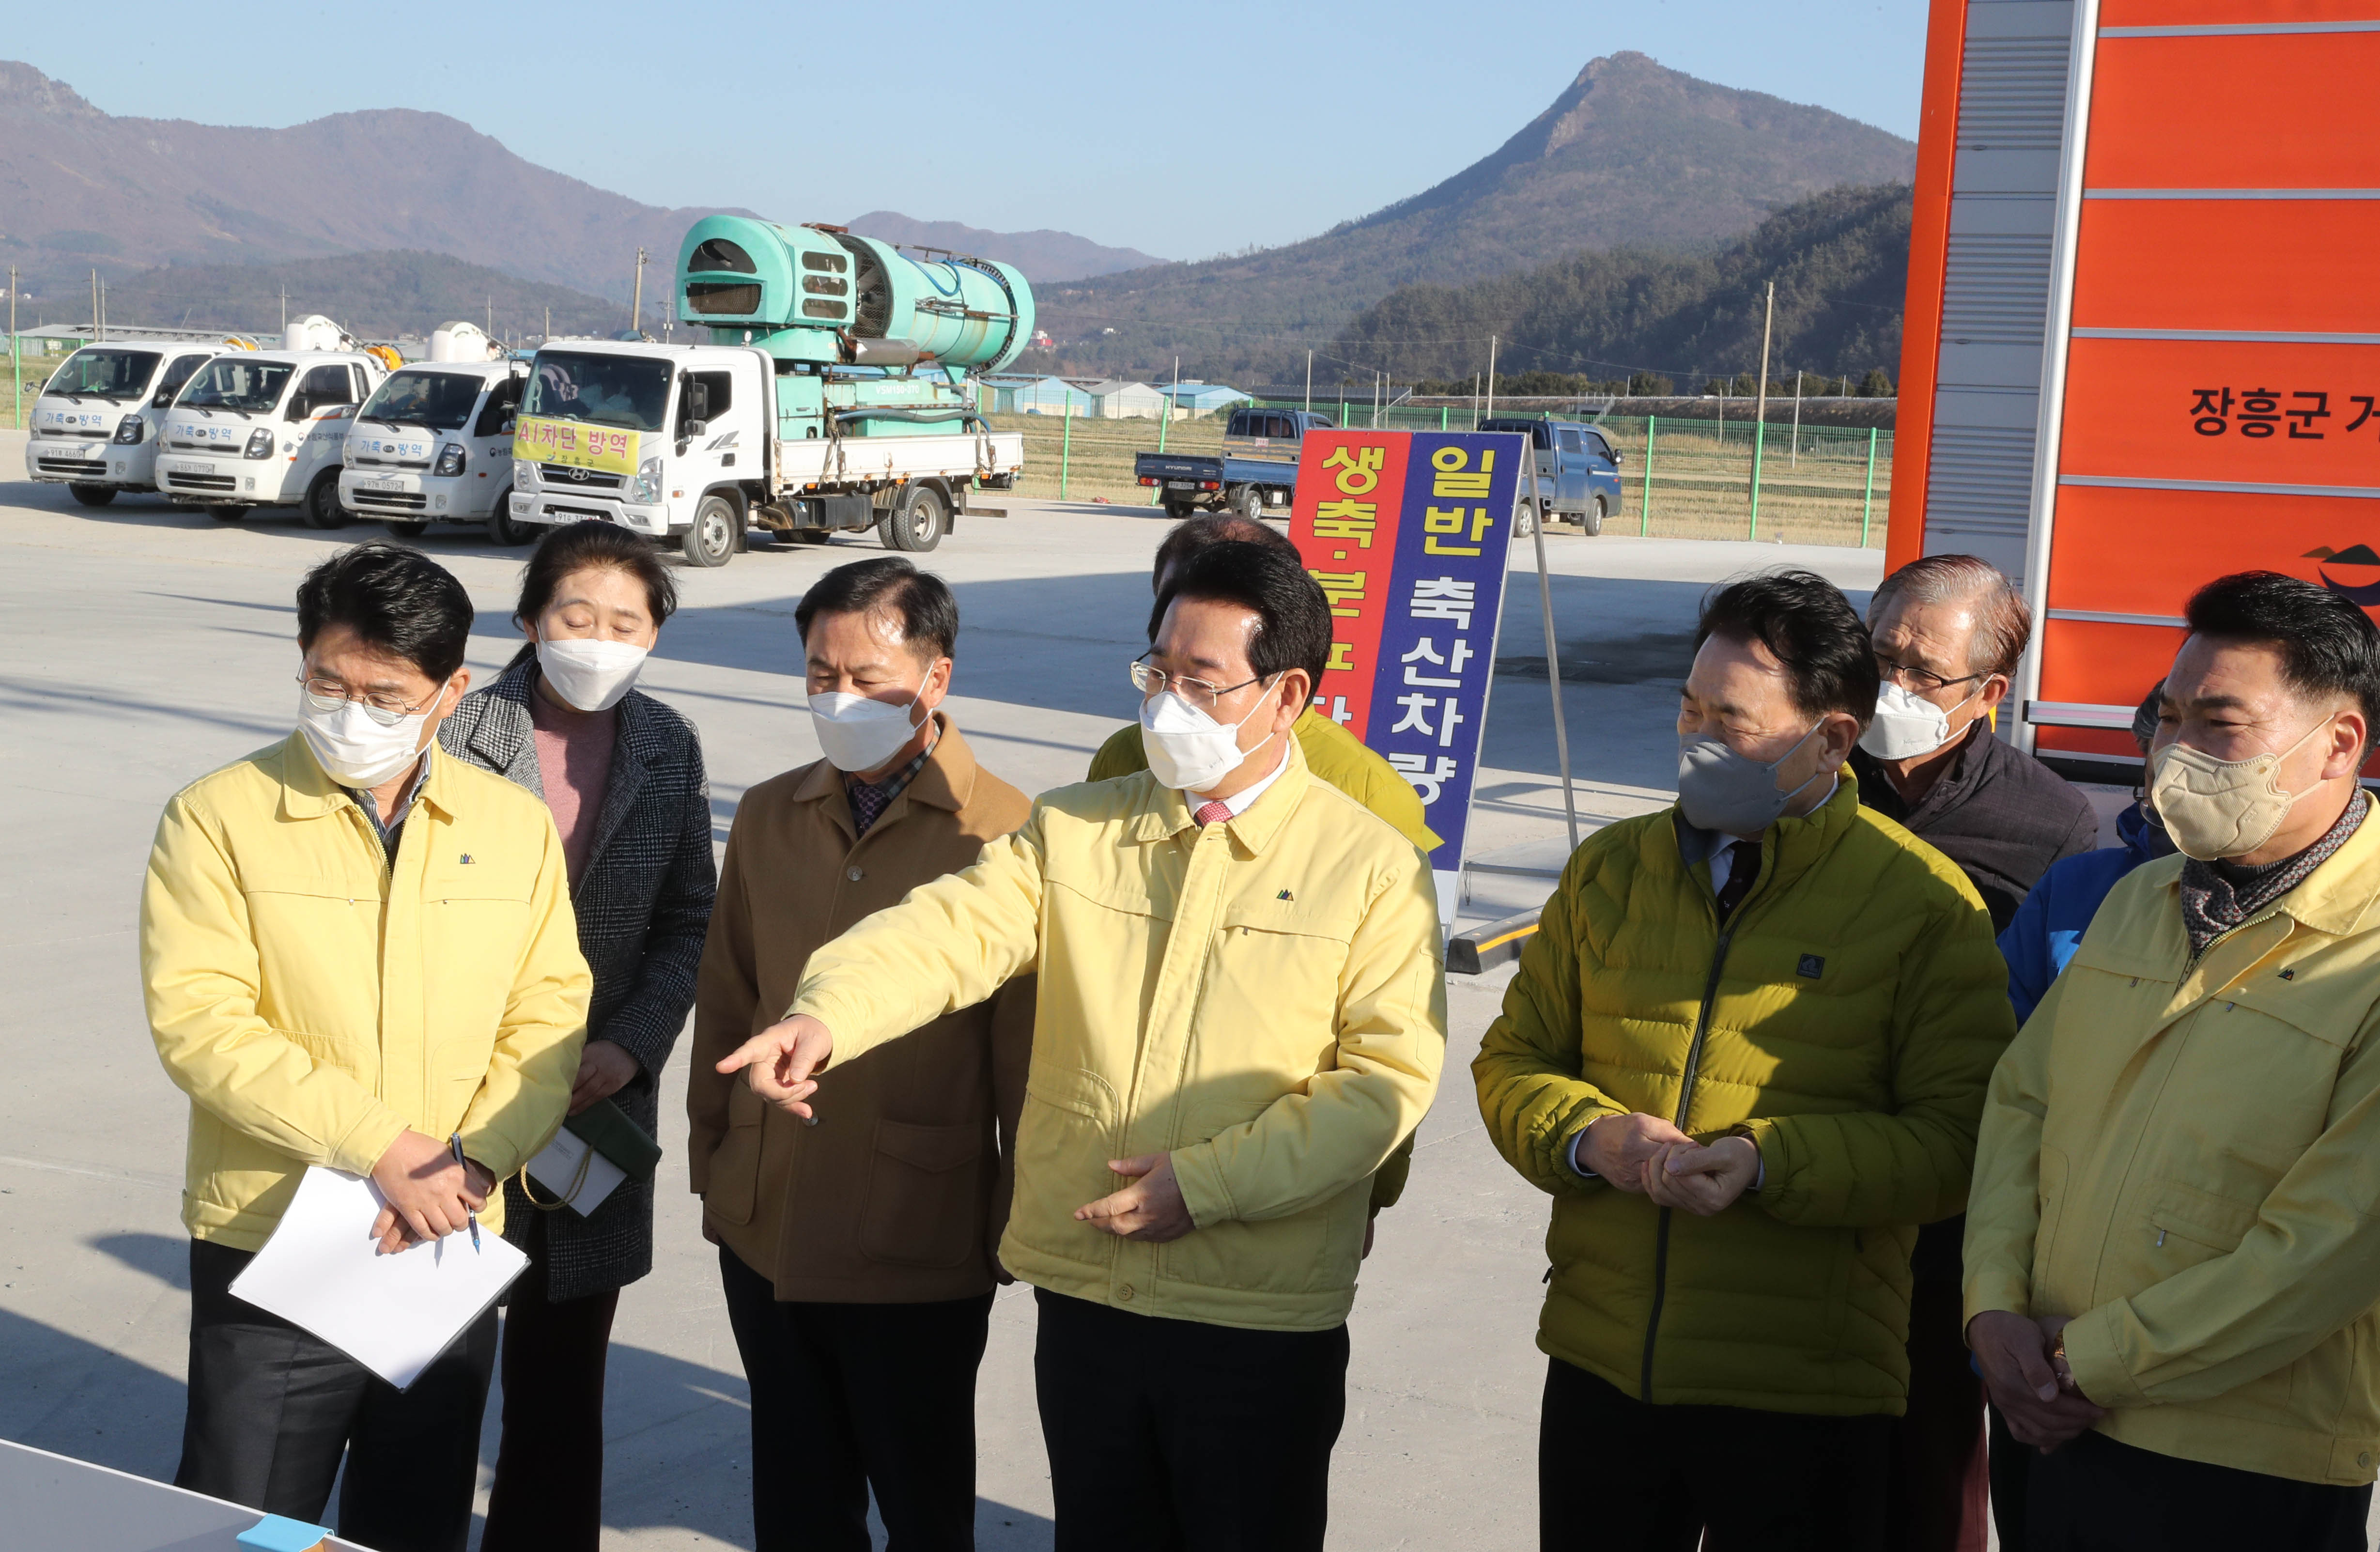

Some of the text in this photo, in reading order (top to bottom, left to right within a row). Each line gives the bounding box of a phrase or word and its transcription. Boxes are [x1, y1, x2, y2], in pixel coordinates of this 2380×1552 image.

[46, 413, 102, 426] 가축 방역
[2189, 387, 2331, 439] 장흥군
[176, 425, 232, 441] 가축 방역
[518, 421, 628, 459] AI차단 방역
[360, 440, 422, 456] 가축 방역
[1388, 446, 1496, 807] 일반 축산차량
